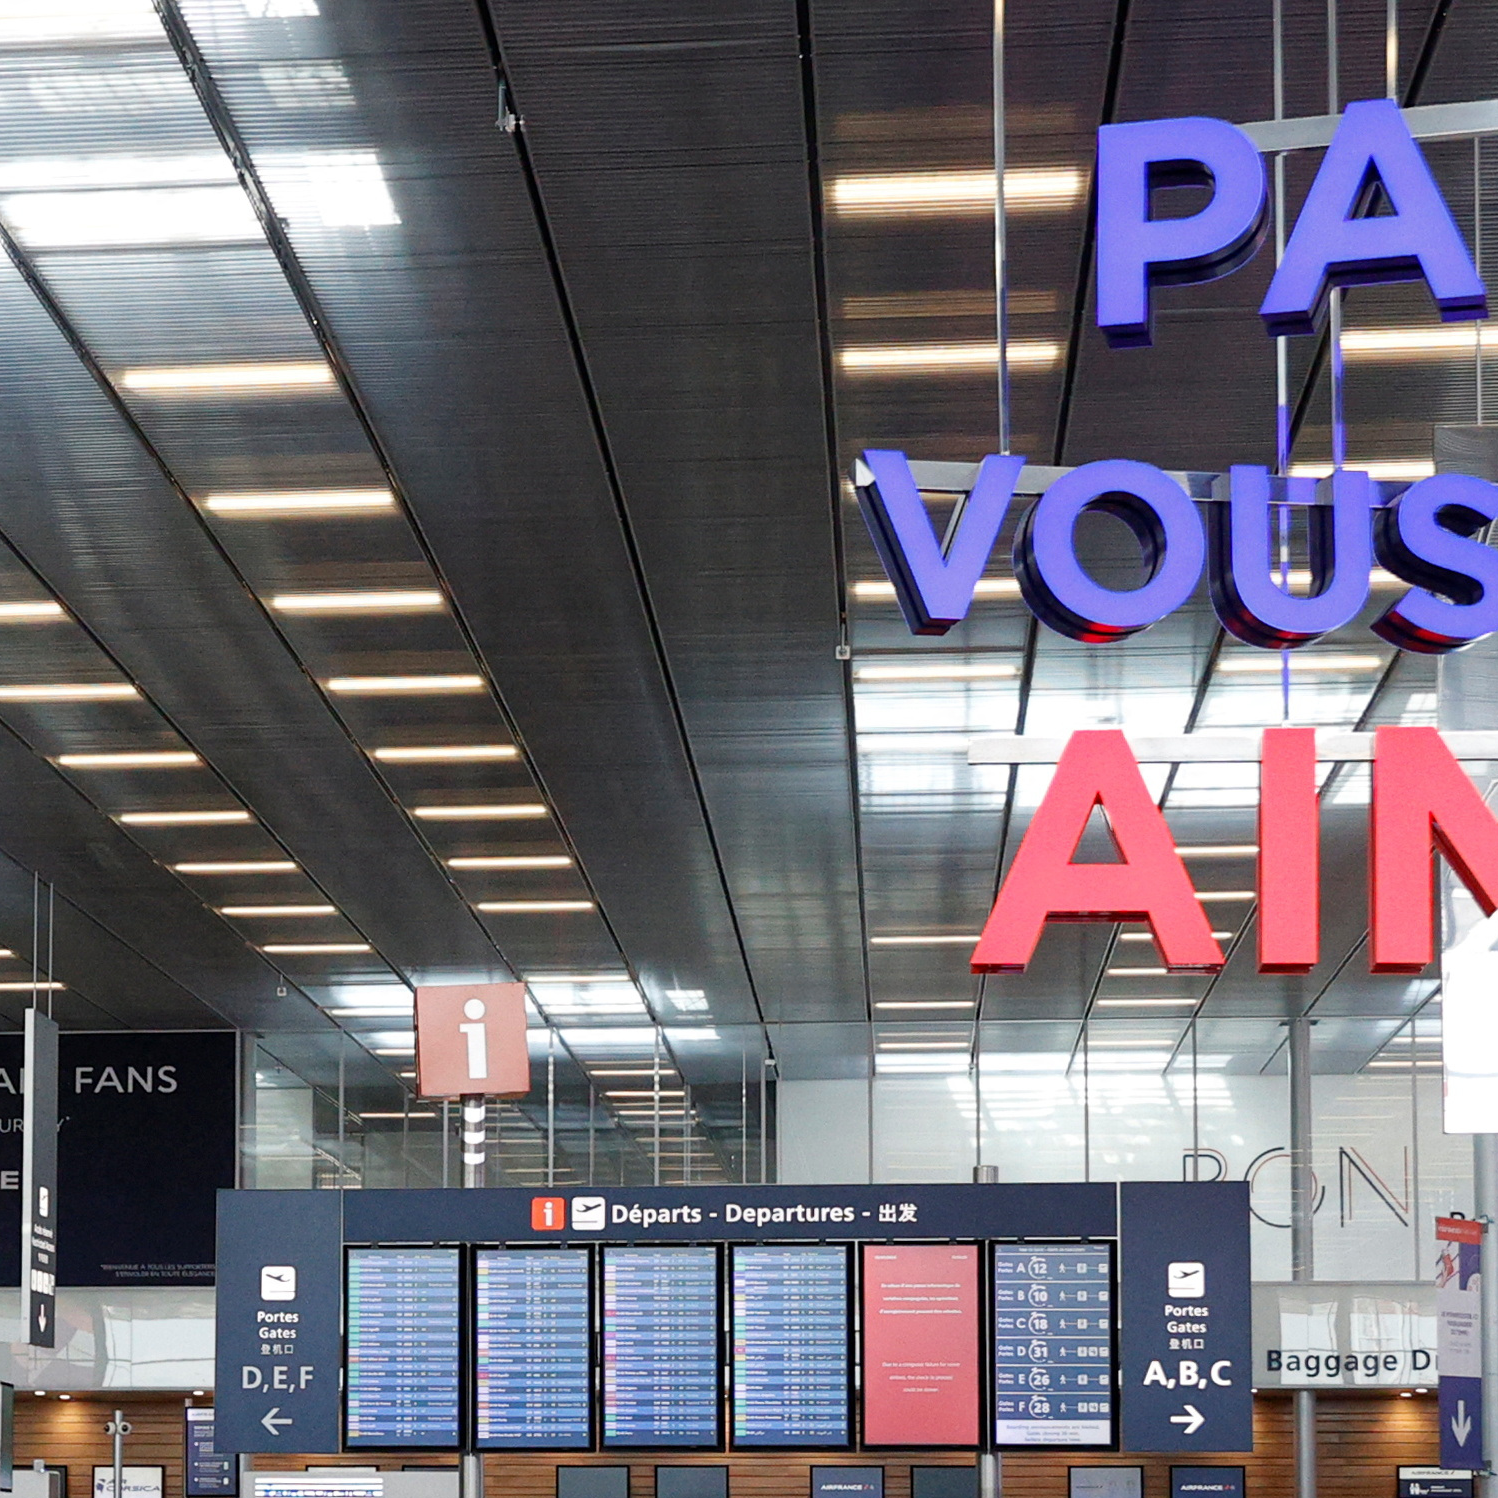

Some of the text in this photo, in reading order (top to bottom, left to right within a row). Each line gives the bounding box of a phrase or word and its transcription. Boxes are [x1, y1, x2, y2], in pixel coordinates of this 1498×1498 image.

[75, 1066, 178, 1094] FANS
[612, 1204, 702, 1230] Départs
[725, 1203, 855, 1228] Departures
[878, 1203, 917, 1223] 出发
[1016, 1263, 1047, 1274] A 12
[1017, 1291, 1048, 1302] B 10
[257, 1310, 299, 1324] Portes
[1164, 1305, 1209, 1318] Portes
[1016, 1318, 1048, 1330] C 18
[1166, 1320, 1207, 1333] Gates
[259, 1326, 297, 1339] Gates
[260, 1342, 295, 1355] 登机口
[1169, 1338, 1205, 1350] 登机口
[1017, 1346, 1048, 1358] D 31
[1266, 1348, 1398, 1378] Baggage
[242, 1366, 314, 1393] D,E,F
[1018, 1374, 1050, 1386] E 26
[1143, 1361, 1232, 1389] A,B,C
[1018, 1402, 1050, 1413] F 28
